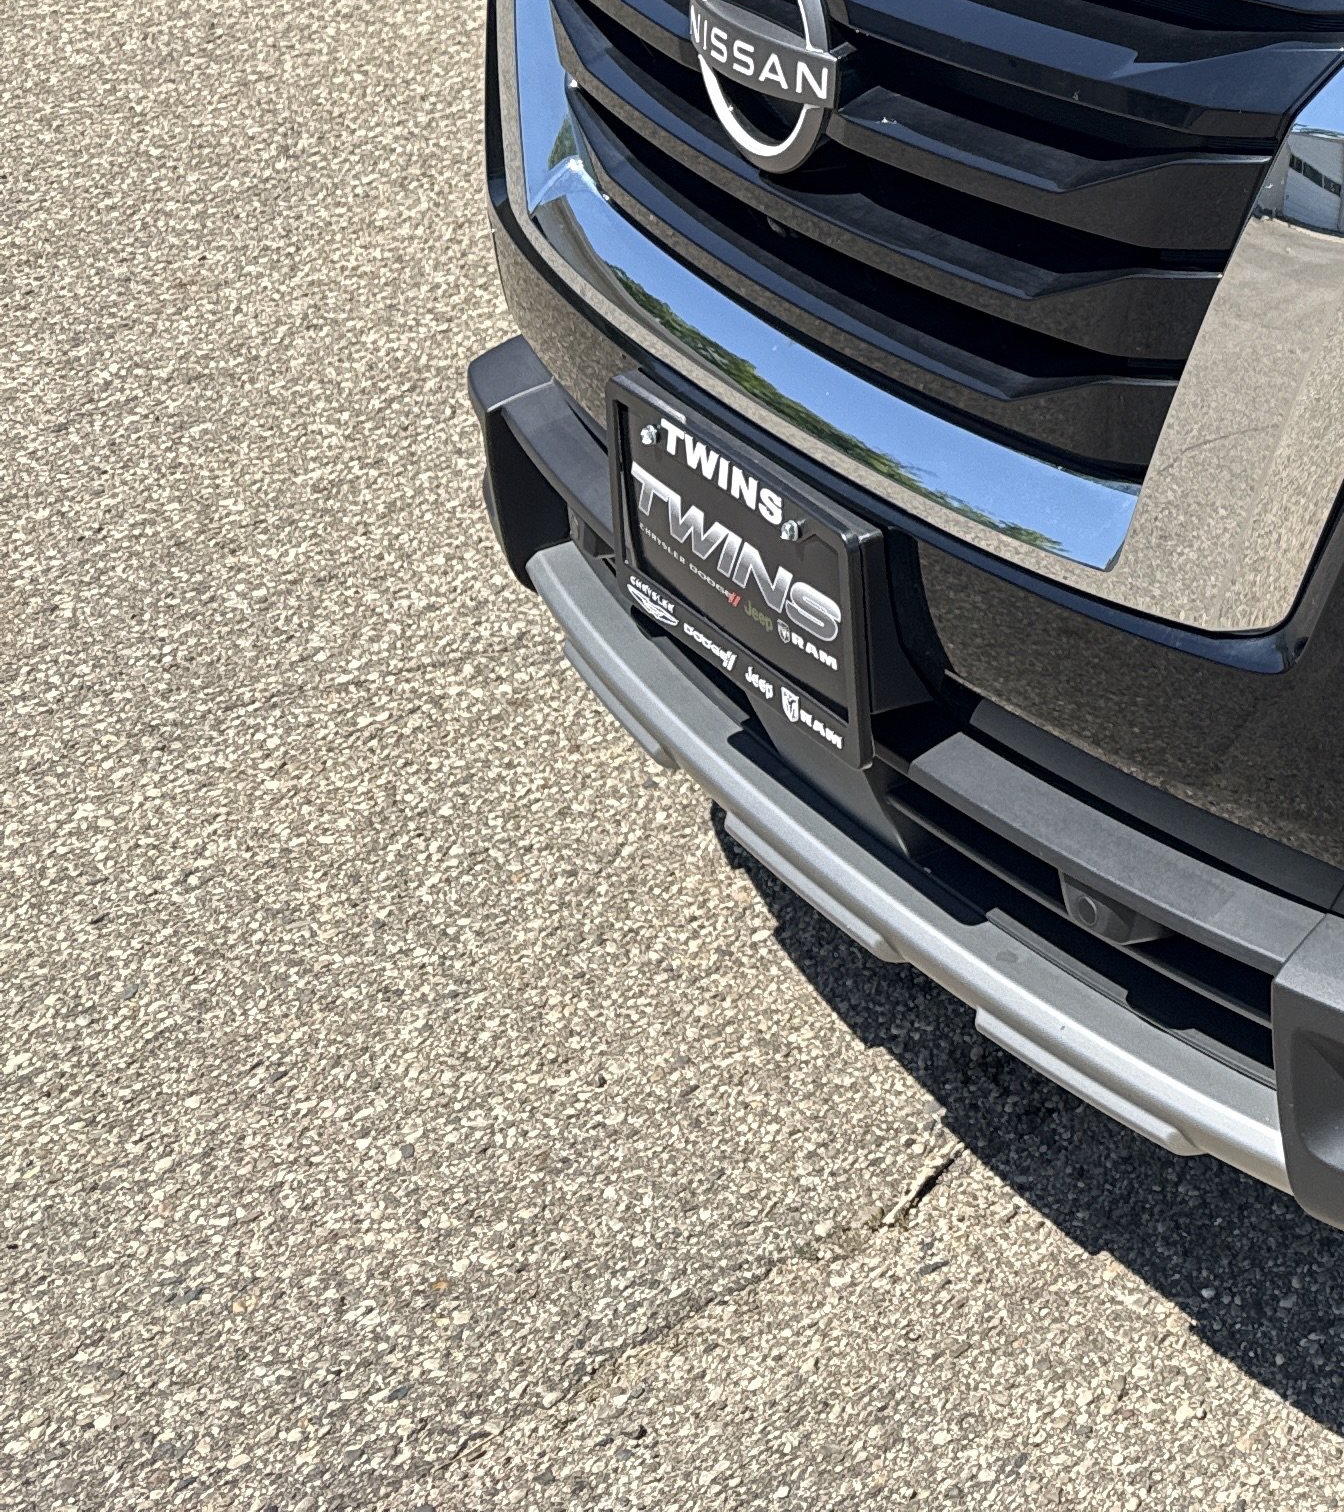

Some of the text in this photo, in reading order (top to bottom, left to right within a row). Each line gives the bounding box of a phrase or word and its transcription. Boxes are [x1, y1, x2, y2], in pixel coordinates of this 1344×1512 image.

[689, 4, 828, 99] NISSAN
[660, 417, 783, 525] TWINS
[629, 575, 675, 615] CHRYSLER
[630, 460, 842, 641] TWINS
[639, 522, 838, 671] CHRYSLER DODGE Jeep RAM
[683, 622, 844, 750] DODGE Jeep RAM
